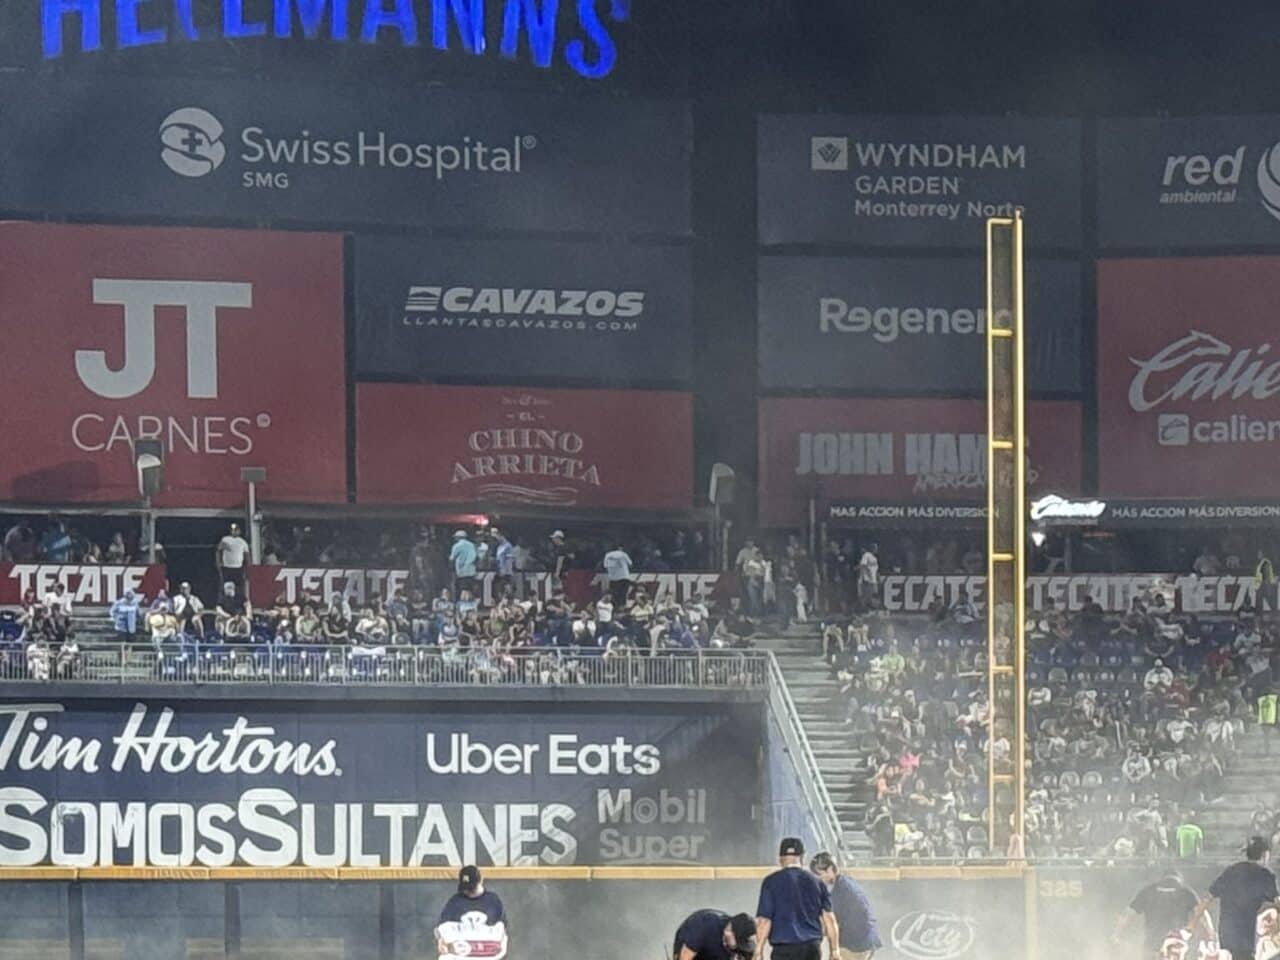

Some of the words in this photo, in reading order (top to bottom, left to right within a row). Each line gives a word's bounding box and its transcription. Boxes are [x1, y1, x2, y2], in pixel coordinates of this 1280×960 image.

[42, 0, 628, 78] HELMANNS
[241, 127, 351, 165] Swiss
[855, 143, 1026, 169] WYNDHAM
[243, 172, 289, 189] SMG
[1162, 145, 1246, 187] red
[855, 175, 960, 195] GARDEN
[854, 200, 961, 221] Monterrey
[442, 287, 645, 317] CAVAZOS
[74, 278, 253, 400] JT
[468, 428, 584, 454] CHINO
[795, 432, 894, 475] JOHN
[450, 454, 601, 487] ARRIETA
[1216, 505, 1280, 518] DIVERSION
[8, 564, 149, 604] TECATE
[878, 574, 988, 611] ECATE
[0, 702, 102, 773] Tim
[426, 733, 540, 775] Uber
[549, 734, 662, 776] Eats
[596, 787, 707, 825] Mobil
[599, 828, 706, 861] Super
